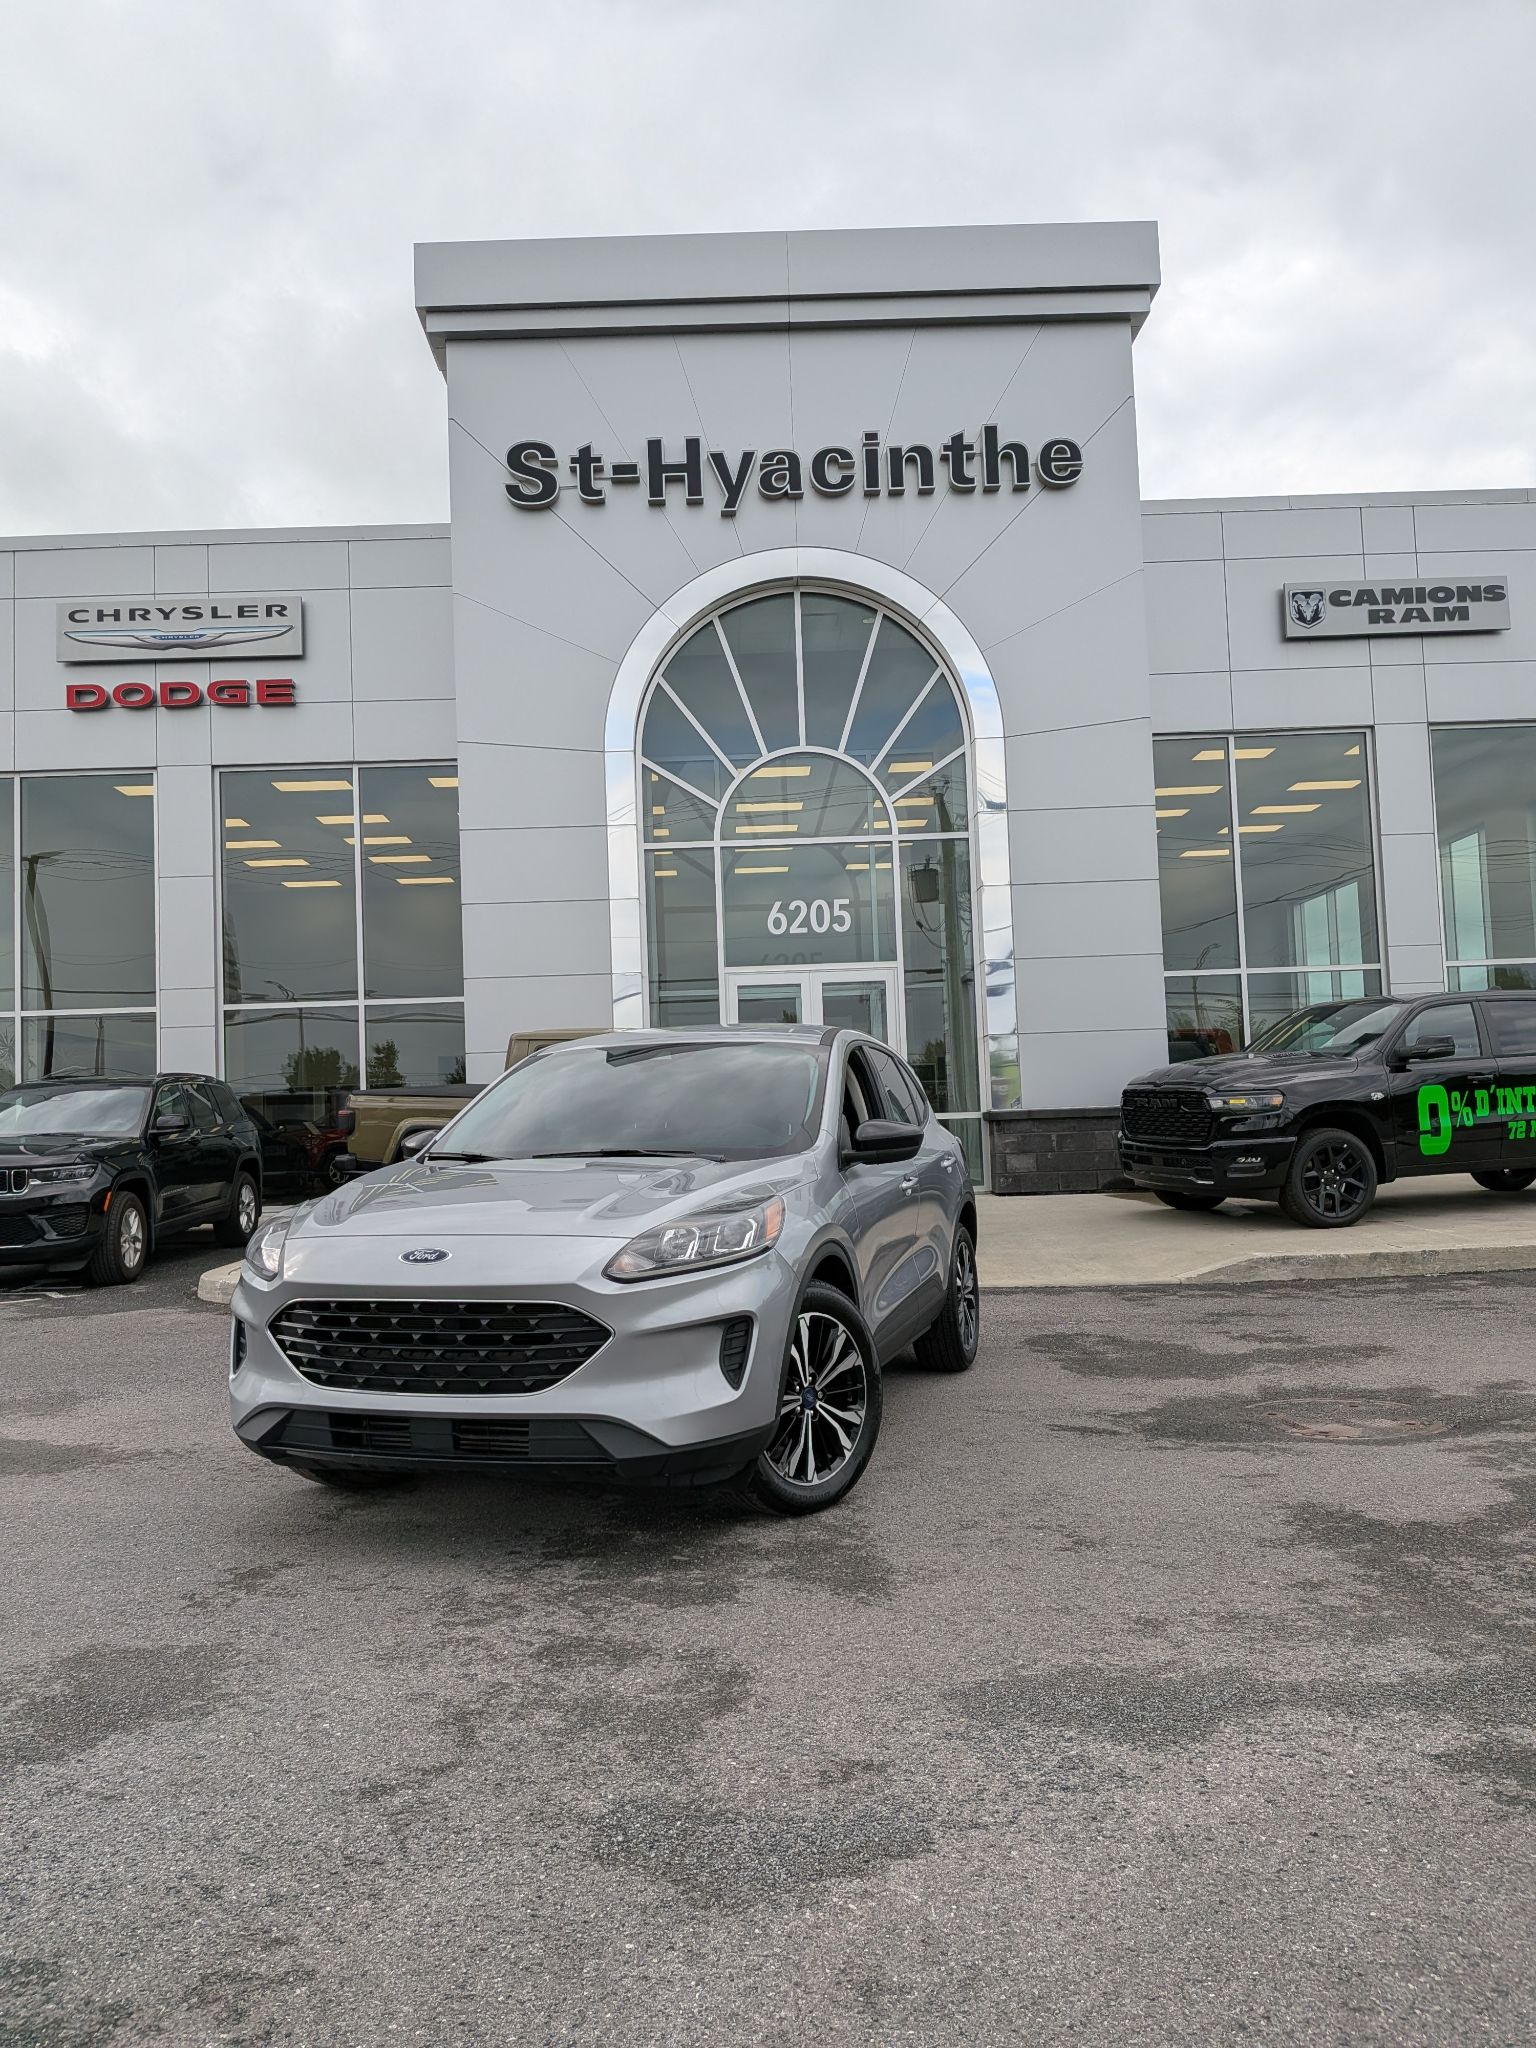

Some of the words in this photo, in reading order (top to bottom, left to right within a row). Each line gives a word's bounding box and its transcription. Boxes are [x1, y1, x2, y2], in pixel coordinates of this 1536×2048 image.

[504, 423, 1085, 518] St-Hyacinthe
[1328, 584, 1507, 607] CAMIONS
[68, 604, 289, 623] CHRYSLER
[1367, 605, 1470, 625] RAM
[66, 679, 296, 709] DODGE
[767, 898, 852, 935] 6205
[1508, 1120, 1527, 1140] 72
[409, 1249, 440, 1260] Ford
